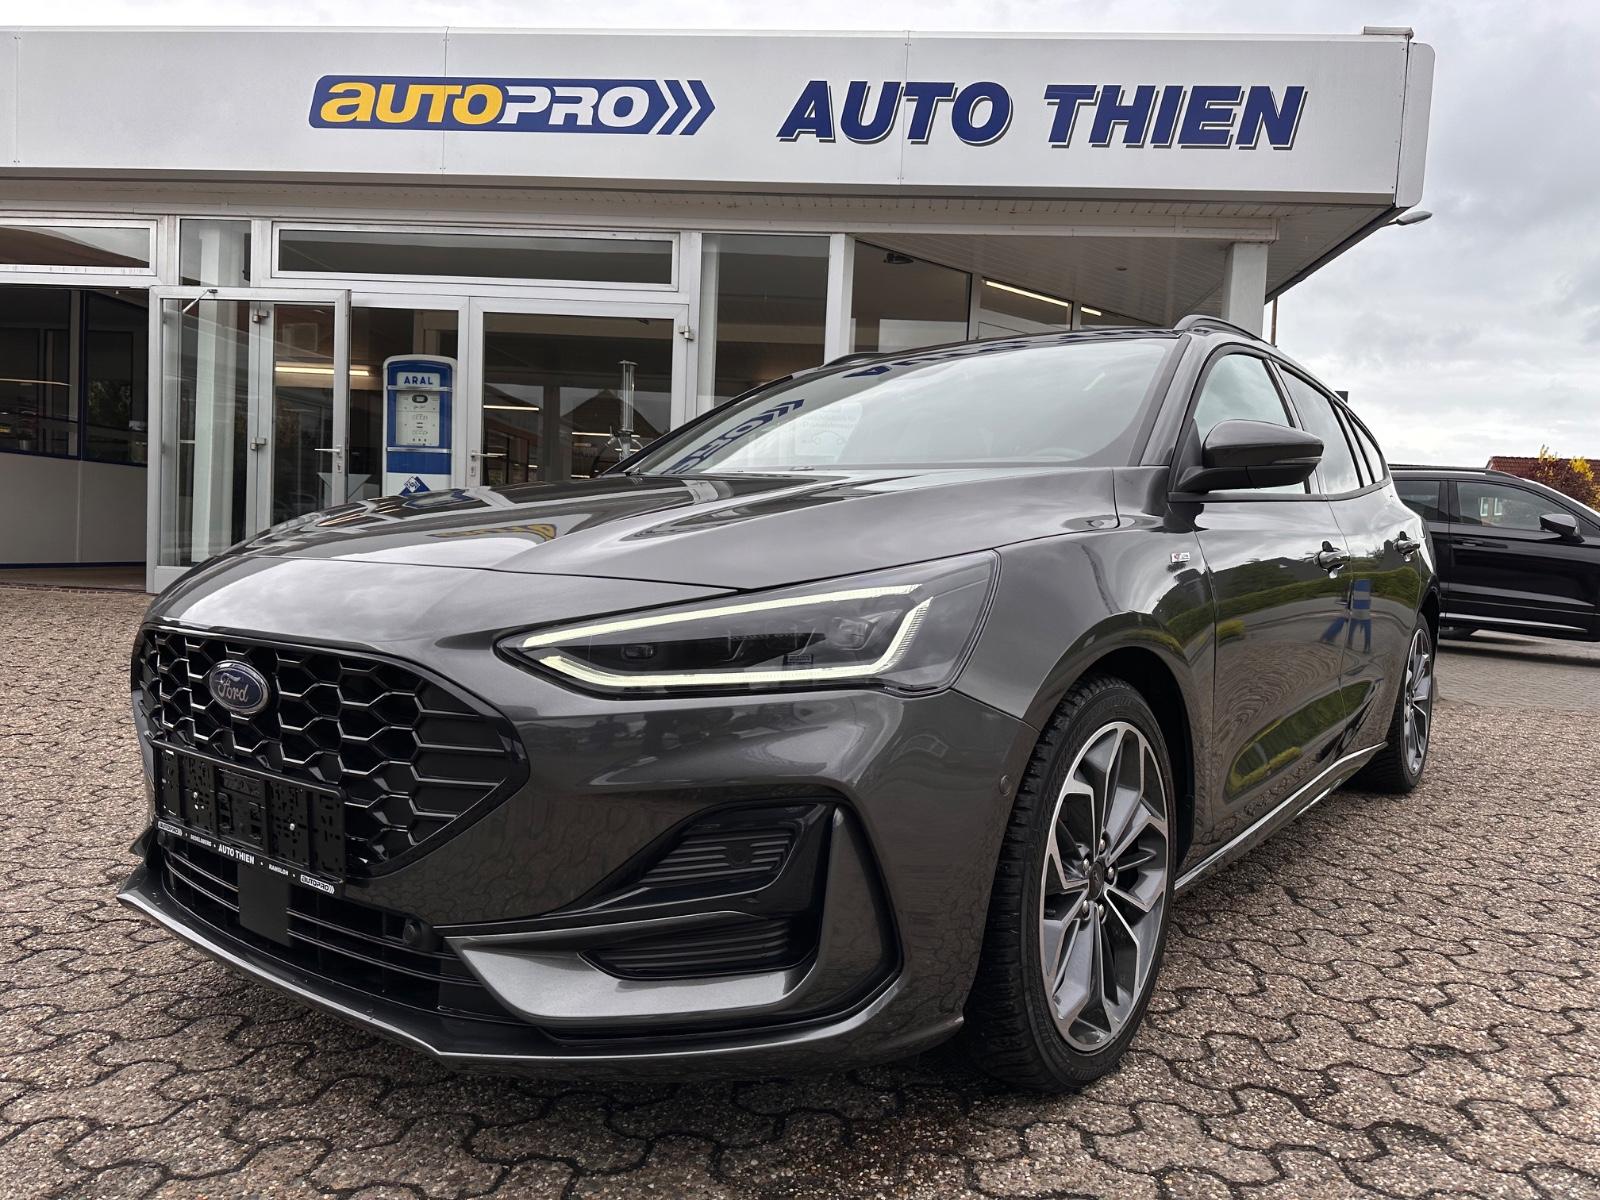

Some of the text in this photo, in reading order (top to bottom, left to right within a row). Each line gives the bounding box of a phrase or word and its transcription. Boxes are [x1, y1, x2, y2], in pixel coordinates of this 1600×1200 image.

[776, 80, 1308, 151] AUTO THIEN
[403, 375, 434, 385] ARAL
[215, 672, 249, 702] Ford
[218, 843, 235, 857] AUTO
[235, 849, 255, 865] THIEN
